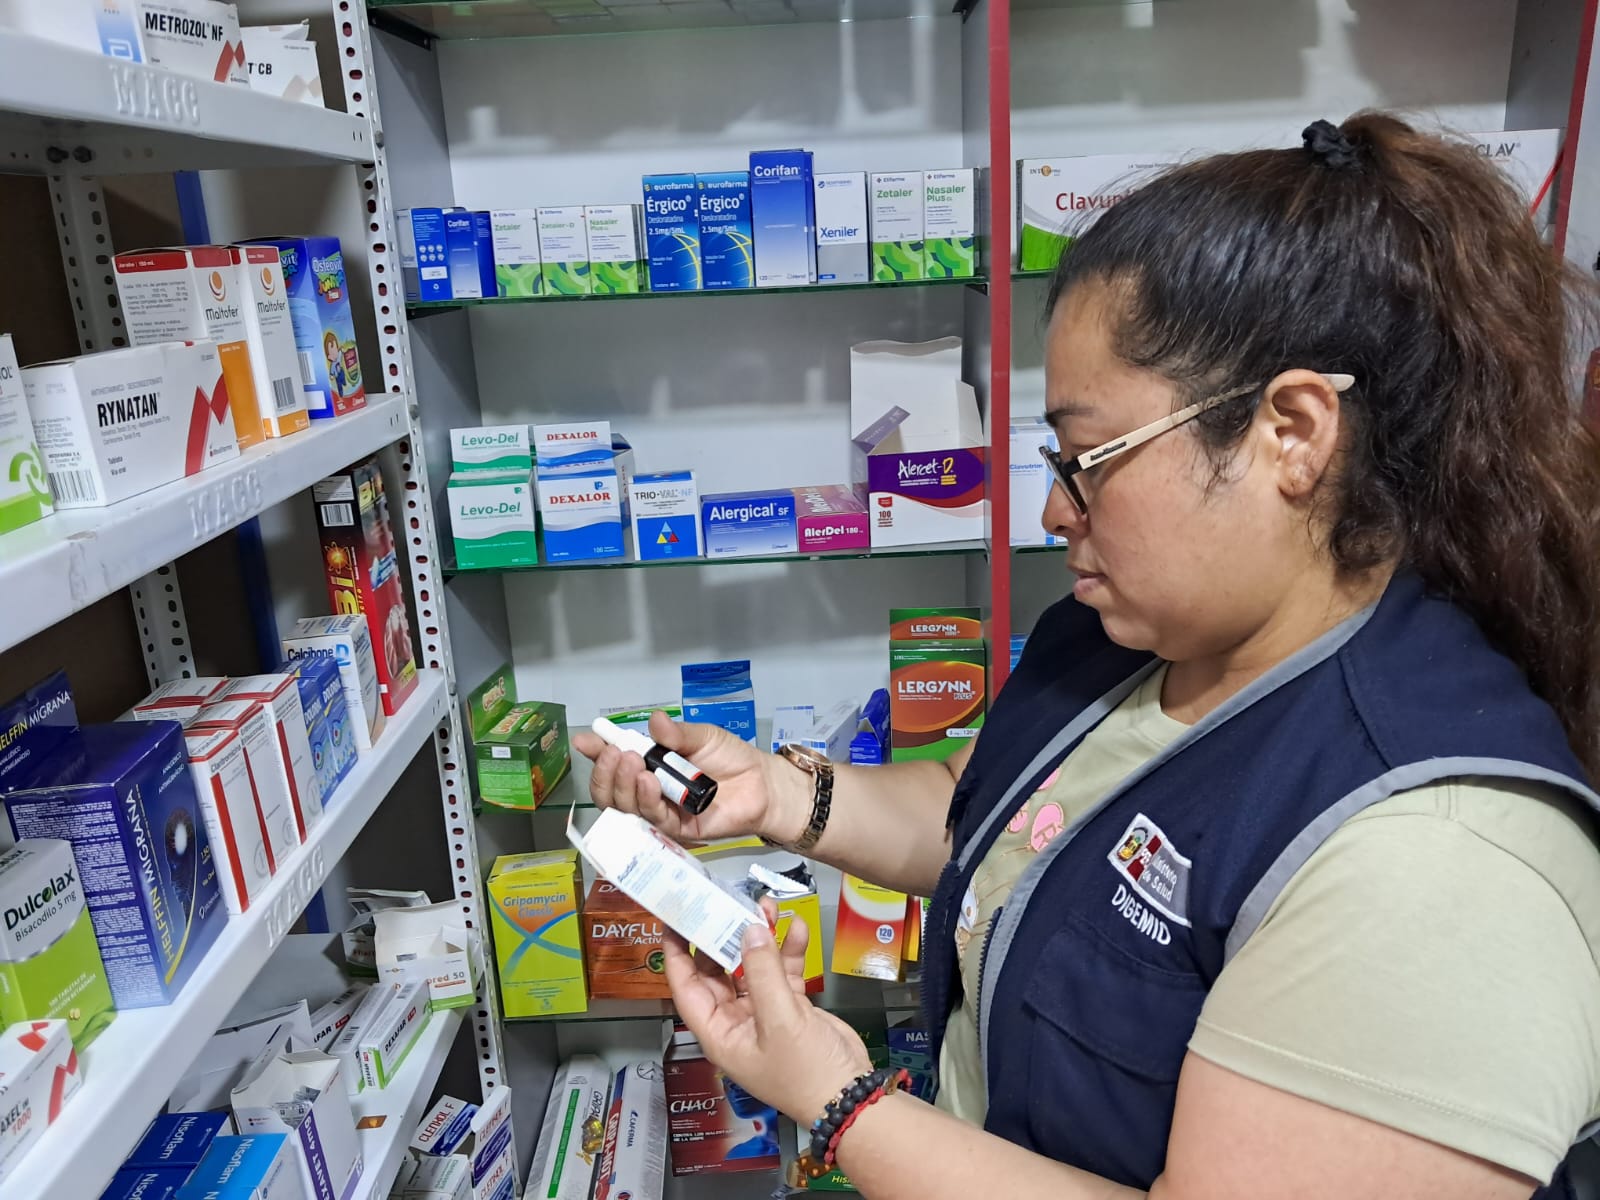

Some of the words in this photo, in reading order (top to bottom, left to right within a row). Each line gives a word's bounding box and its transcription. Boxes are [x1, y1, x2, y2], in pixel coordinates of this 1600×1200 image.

[145, 12, 208, 39] METROZOL
[211, 26, 224, 42] NF
[258, 63, 273, 75] CB
[754, 165, 800, 177] Corifan
[653, 182, 694, 191] eurofarma
[707, 181, 748, 189] eurofarma
[926, 184, 966, 195] Nasaler
[877, 188, 913, 199] Zetaler
[927, 194, 946, 202] Plus
[646, 195, 687, 215] Érgico
[700, 193, 740, 213] Érgico
[820, 226, 859, 239] Xeniler
[205, 304, 239, 321] Maltofer
[257, 299, 286, 314] Maltofer
[0, 366, 12, 381] OL
[96, 392, 159, 428] RYNATAN
[461, 432, 519, 447] Levo-Del
[546, 431, 598, 441] DEXALOR
[549, 491, 611, 505] DEXALOR
[460, 502, 521, 516] Levo-Del
[709, 502, 775, 522] Alergical
[777, 506, 790, 516] SF
[878, 510, 892, 518] 100
[804, 525, 845, 537] AlerDel
[910, 624, 957, 633] LERGYNN
[898, 680, 971, 694] LERGYNN
[953, 692, 973, 700] PLUS
[28, 689, 72, 729] MIGRAÑA
[126, 788, 156, 882] MIGRAÑA
[1151, 875, 1177, 903] Salud
[4, 867, 76, 931] Dulcolax
[503, 892, 566, 907] Gripamycin
[15, 907, 57, 942] Bisacodilo
[57, 901, 64, 910] 5
[64, 891, 77, 908] mg
[1111, 883, 1172, 946] DIGEMID
[149, 888, 176, 963] HELFFIN
[879, 928, 893, 938] 120
[453, 971, 465, 980] 50
[444, 1102, 455, 1110] F
[670, 1097, 716, 1114] CHAO
[12, 1107, 33, 1136] 1000
[159, 1116, 199, 1160] Nisoflam
[304, 1115, 316, 1150] 4mg
[217, 1138, 256, 1184] Nisoflam
